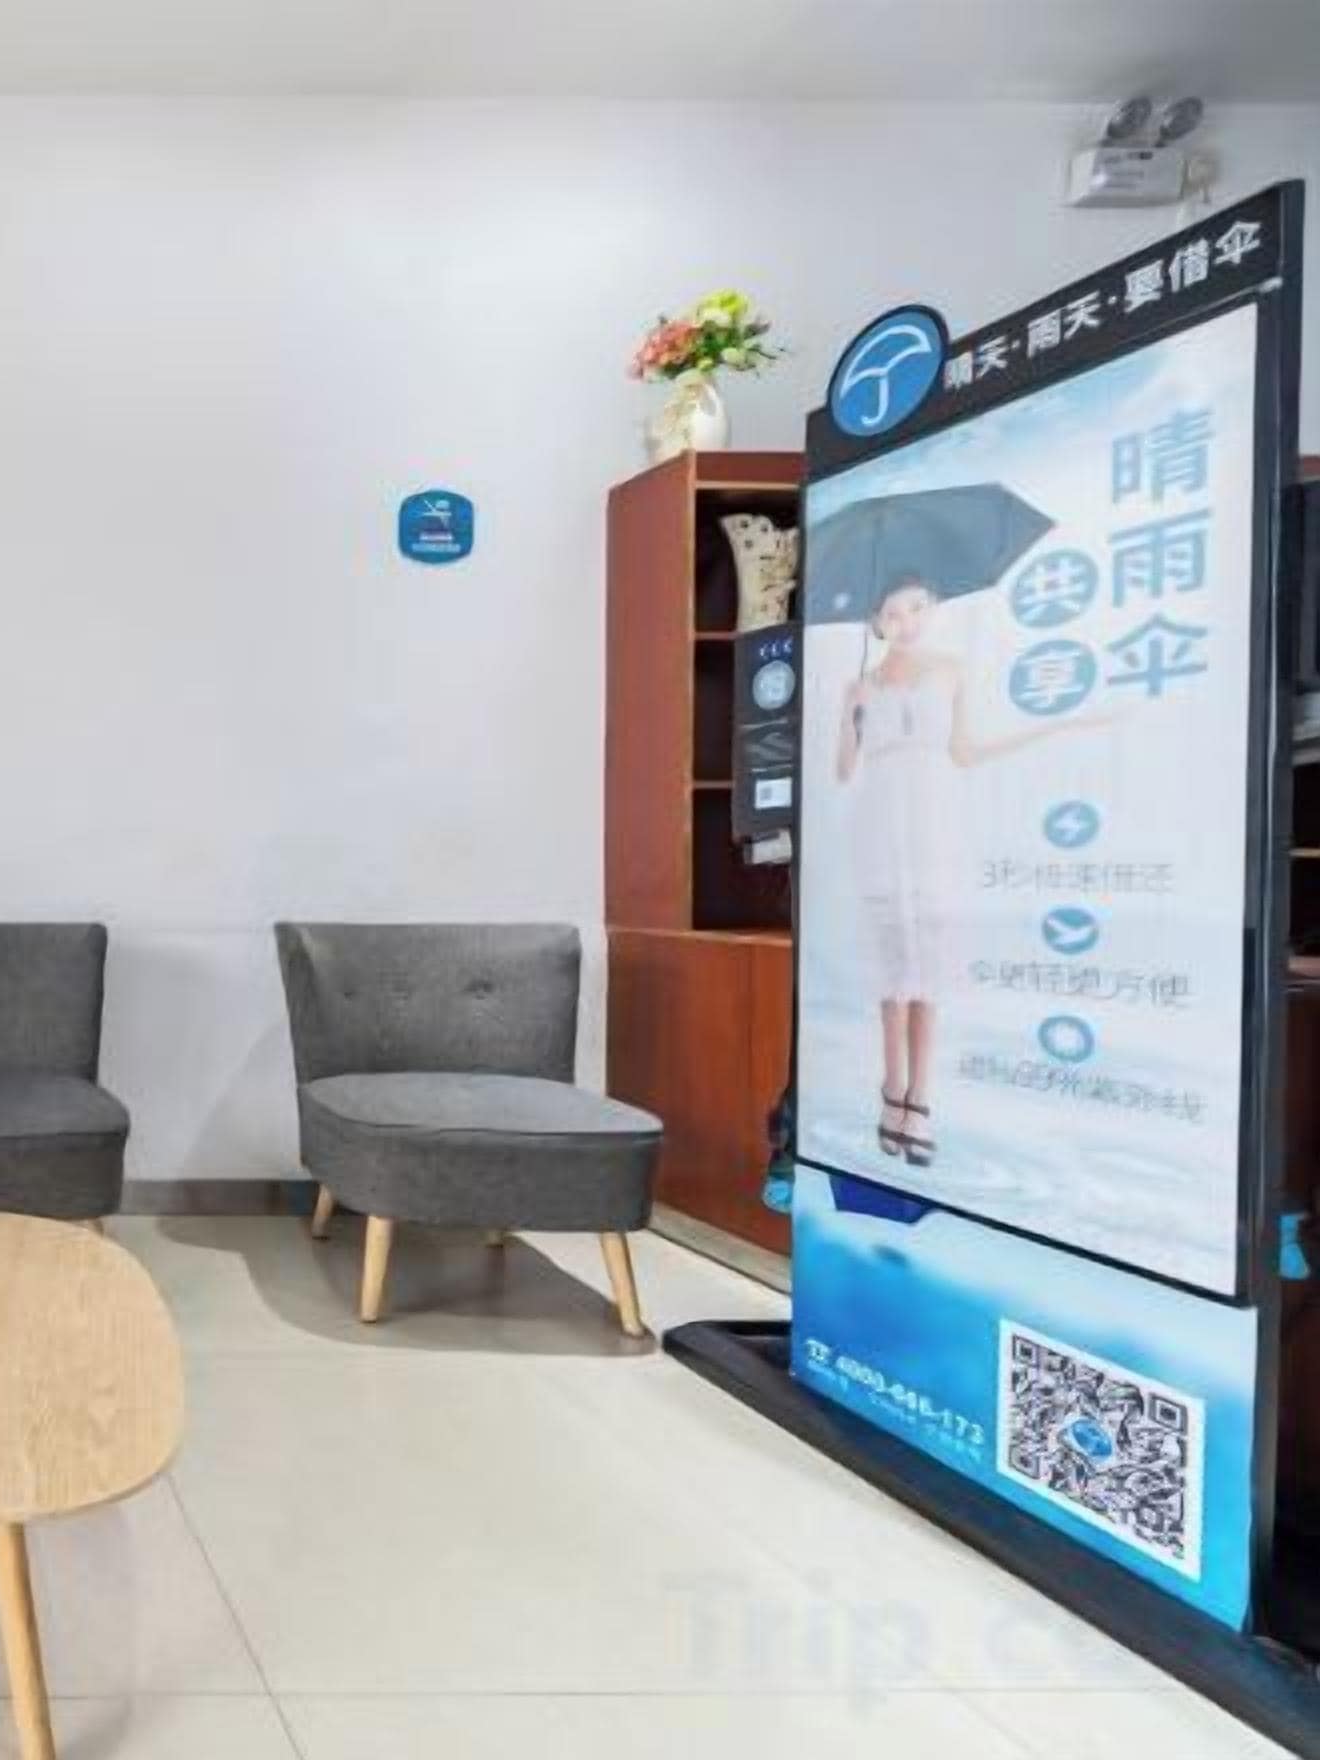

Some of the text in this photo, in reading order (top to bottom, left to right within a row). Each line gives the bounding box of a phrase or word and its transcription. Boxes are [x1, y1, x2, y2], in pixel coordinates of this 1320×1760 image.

[1016, 556, 1089, 712] 共享
[1107, 407, 1214, 697] 晴雨伞
